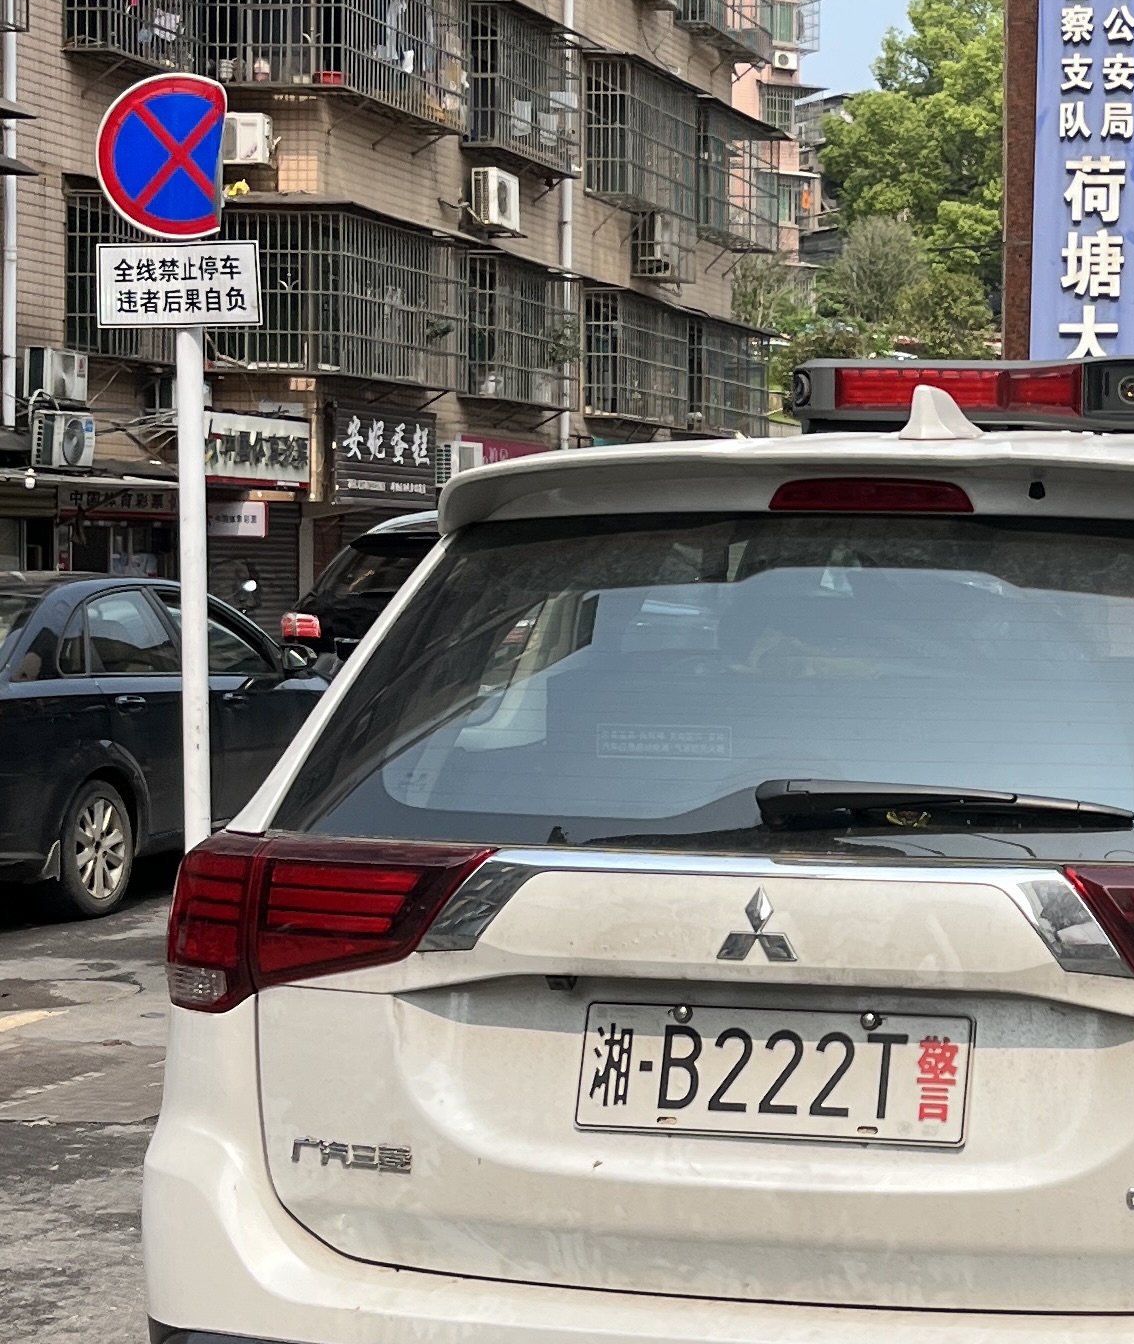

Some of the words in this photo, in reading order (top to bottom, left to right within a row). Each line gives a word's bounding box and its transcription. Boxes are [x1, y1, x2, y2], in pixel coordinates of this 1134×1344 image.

[114, 255, 241, 282] 全线禁止停车
[117, 287, 247, 313] 违者后果自负
